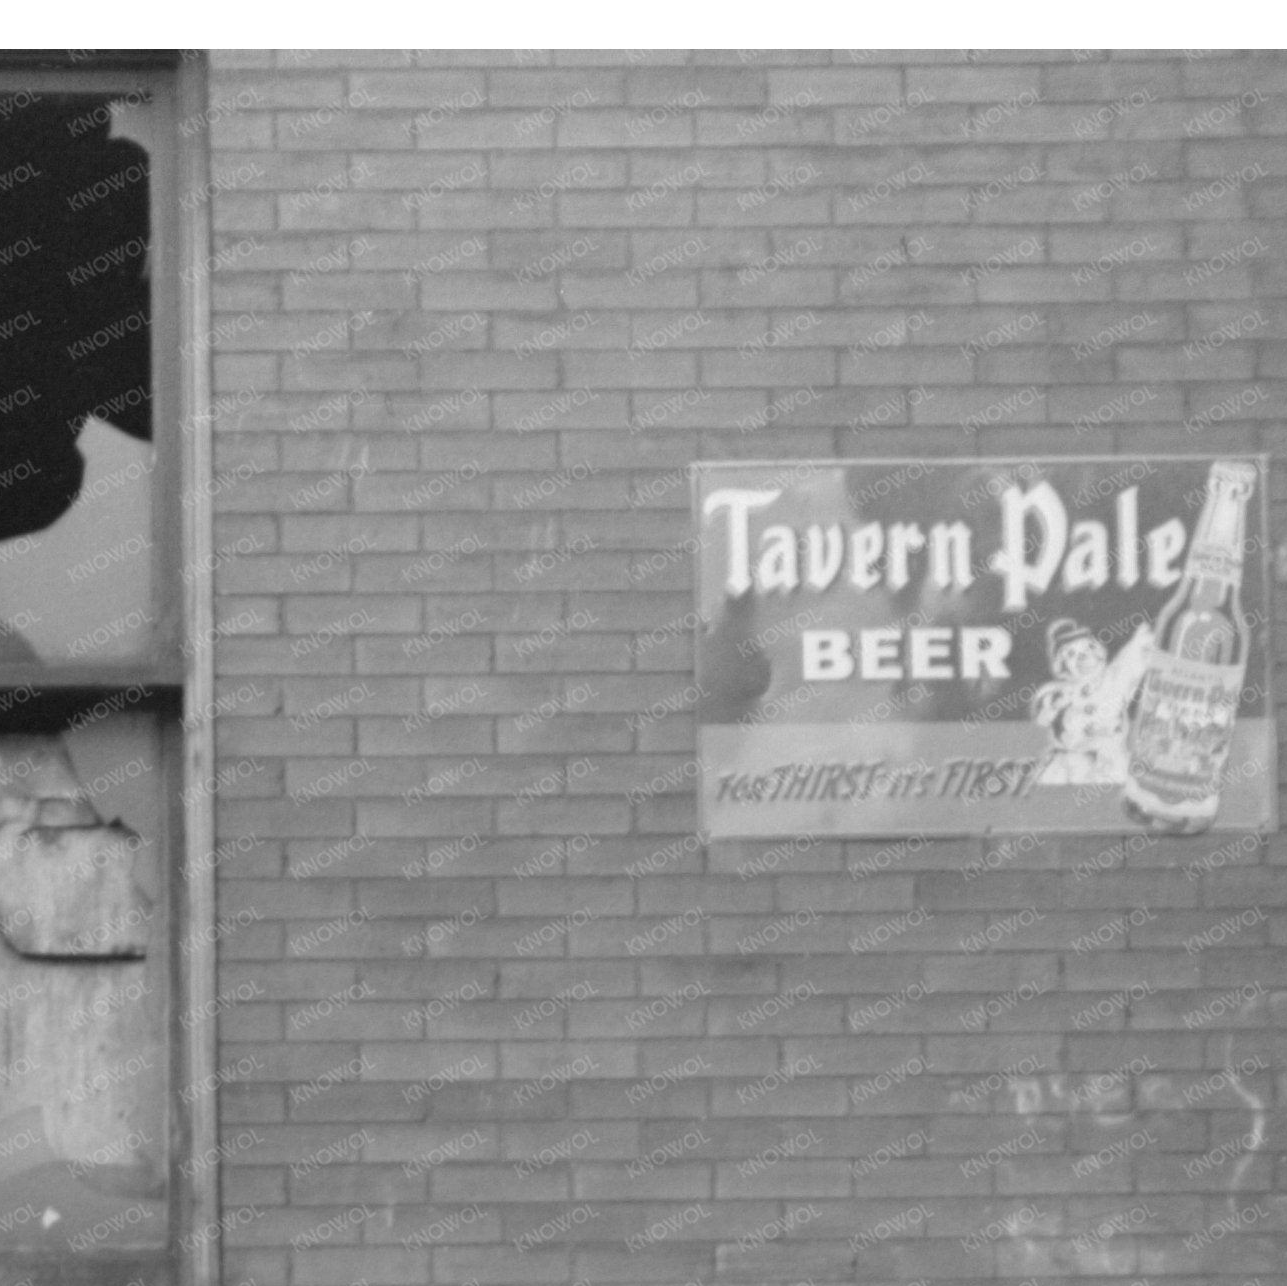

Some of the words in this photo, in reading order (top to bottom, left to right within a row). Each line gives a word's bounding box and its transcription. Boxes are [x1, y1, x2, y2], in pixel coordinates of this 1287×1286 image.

[703, 488, 976, 598] Tavern
[990, 480, 1187, 612] Pale
[802, 627, 1012, 681] BEER
